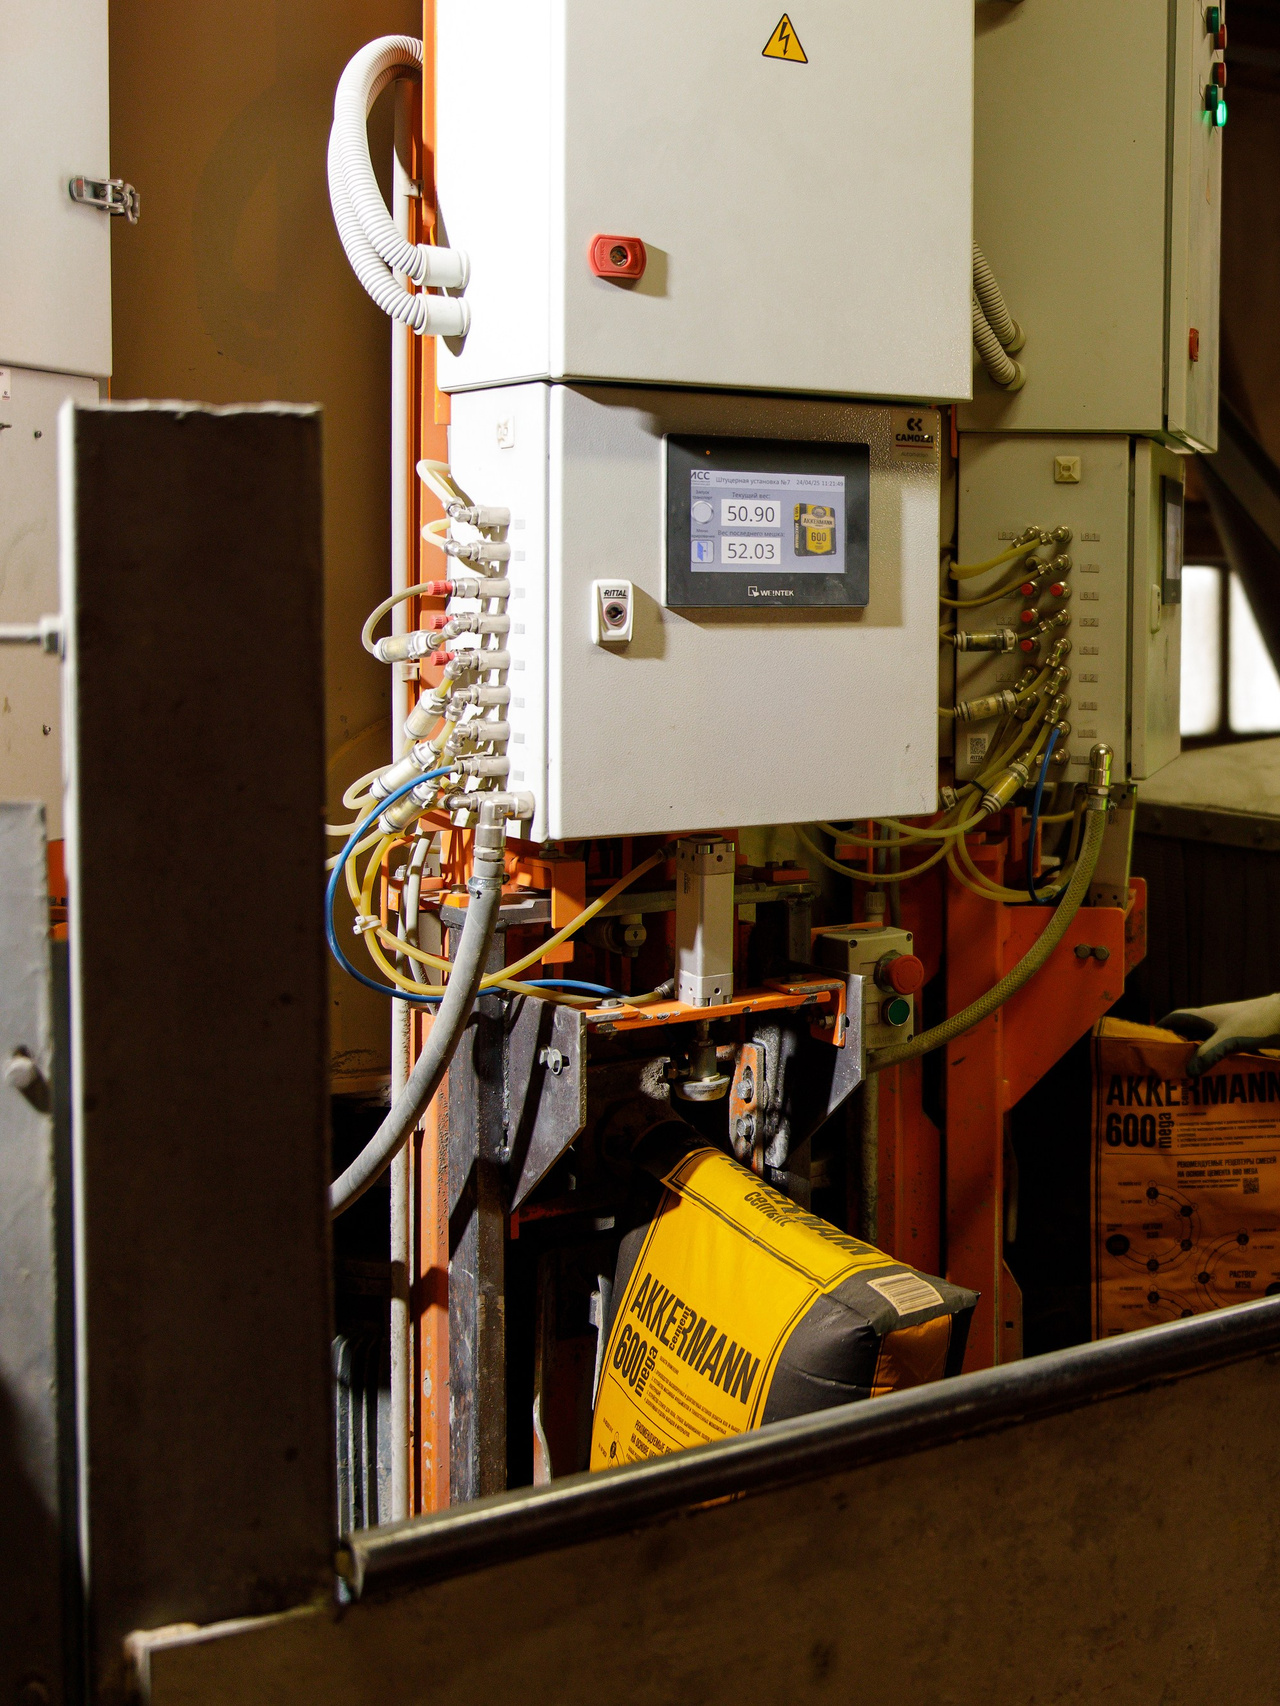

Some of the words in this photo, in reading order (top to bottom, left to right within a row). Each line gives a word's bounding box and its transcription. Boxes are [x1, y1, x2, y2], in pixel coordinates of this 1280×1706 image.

[895, 433, 934, 444] CAMOZZI
[715, 476, 748, 486] Штуцерная
[749, 478, 779, 487] установка
[780, 478, 791, 486] №7
[732, 492, 756, 501] Текущий
[727, 505, 775, 523] 50.90
[732, 531, 763, 540] последнего
[811, 532, 827, 543] 600
[727, 543, 775, 561] 52.03
[604, 589, 627, 597] RITTAL
[1106, 1112, 1157, 1148] 600
[1158, 1112, 1174, 1149] mega
[668, 1305, 692, 1351] cement
[630, 1272, 761, 1405] AKKERMANN
[613, 1323, 648, 1388] 600
[634, 1345, 659, 1398] mega
